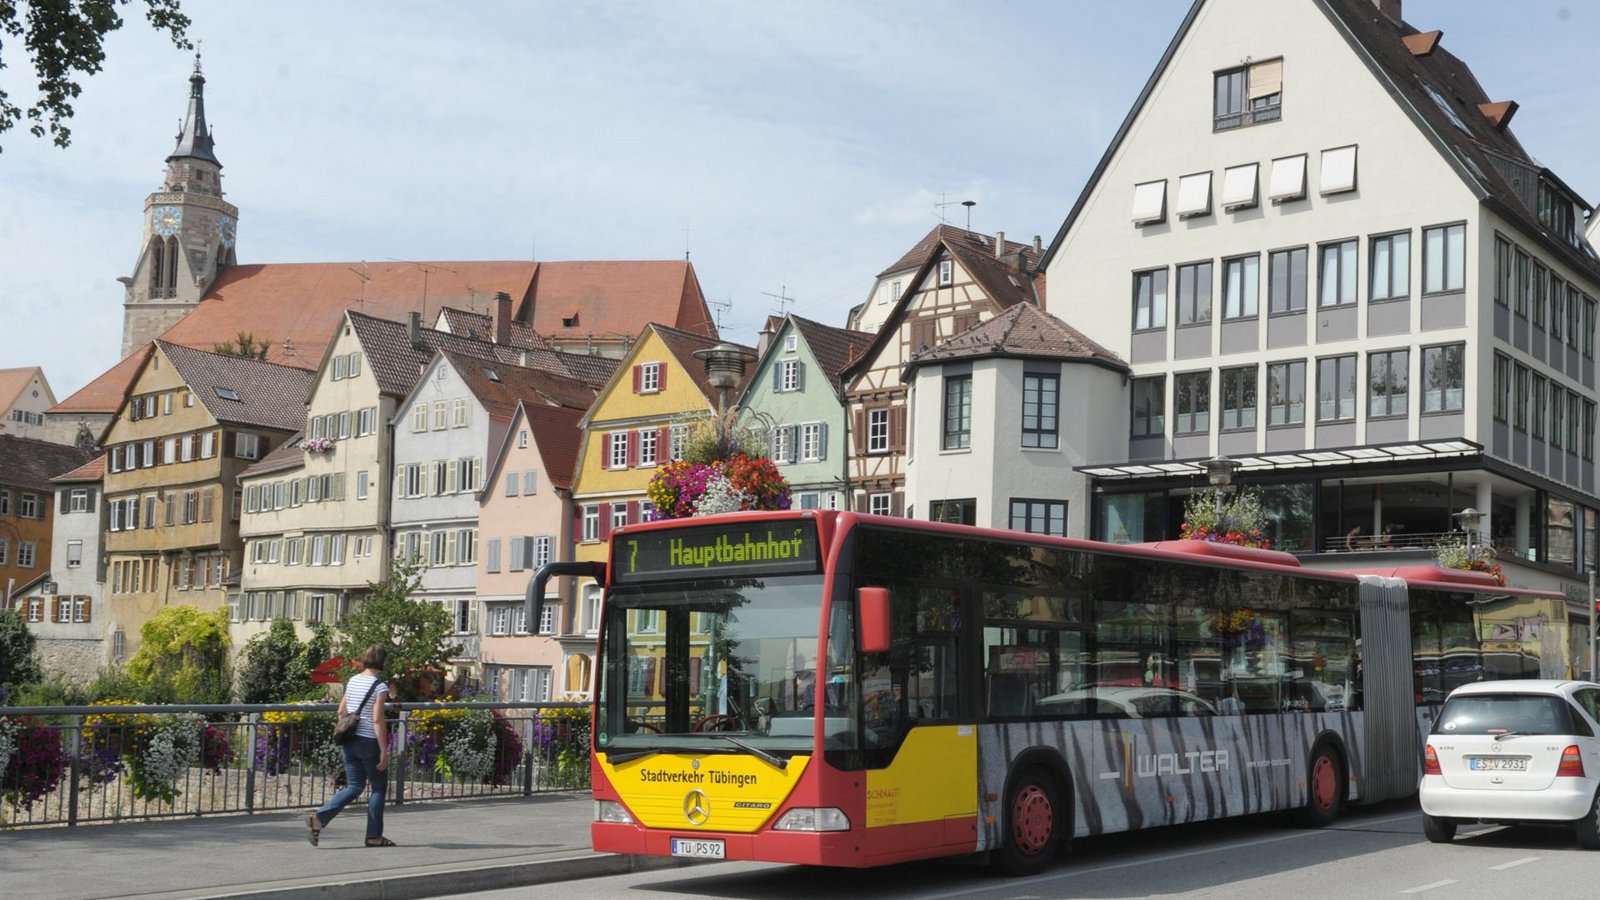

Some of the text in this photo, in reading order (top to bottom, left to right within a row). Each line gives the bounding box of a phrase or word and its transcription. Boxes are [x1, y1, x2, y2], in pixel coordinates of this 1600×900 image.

[628, 528, 802, 573] 7 Hauptbahnhof
[1137, 750, 1229, 778] WALTER
[1476, 760, 1525, 769] ES V 2931
[640, 769, 757, 788] Stadtverkehr Tübingen
[680, 842, 721, 855] TÜ PS 92
